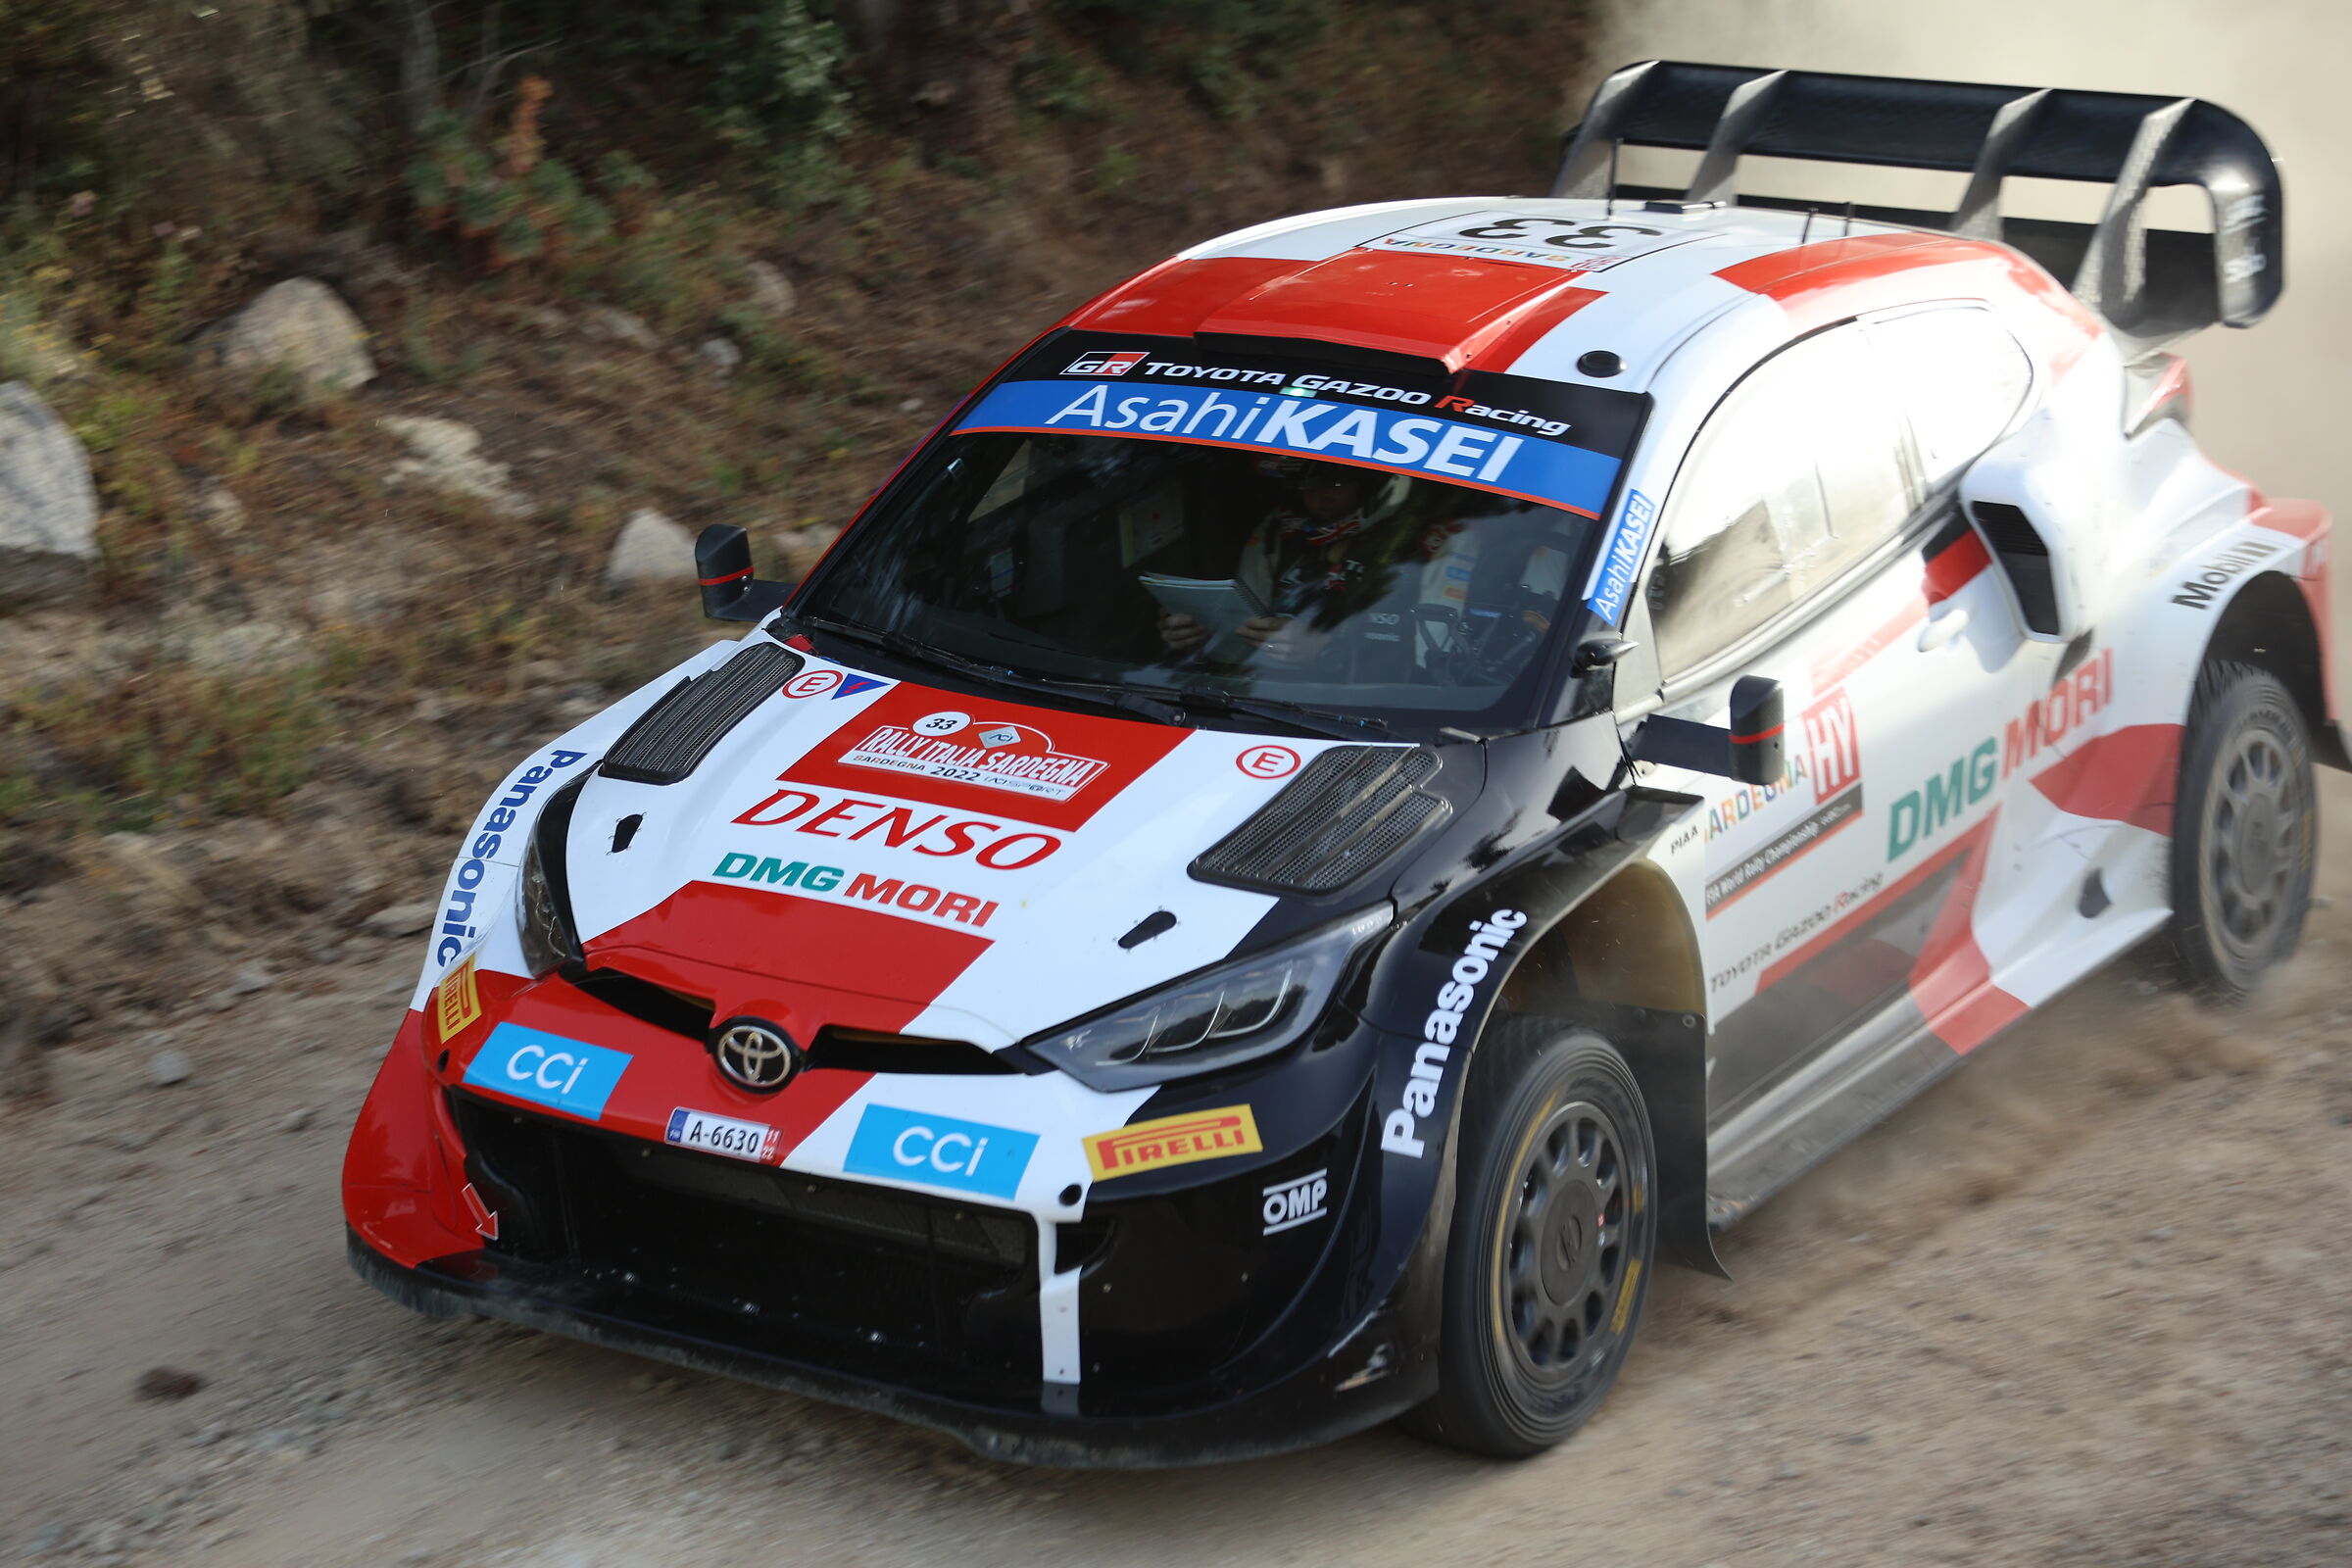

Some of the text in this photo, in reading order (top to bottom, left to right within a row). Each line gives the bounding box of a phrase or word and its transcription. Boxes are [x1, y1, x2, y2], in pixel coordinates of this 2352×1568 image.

[1458, 218, 1662, 249] 33
[1067, 361, 1133, 373] GR
[1145, 362, 1572, 436] TOYOTA GAZOO Racing
[1047, 384, 1524, 482] AsahiKASEI
[1594, 494, 1651, 620] AsahiKASEI
[925, 718, 957, 730] 33
[853, 755, 926, 770] SARDEGNA
[930, 766, 980, 781] 2022
[861, 728, 1097, 786] RALLY ITALIA SARDEGNA
[1251, 752, 1285, 772] E
[1886, 648, 2112, 863] DMG MORI
[731, 789, 1061, 869] DENSO
[437, 750, 588, 968] Panasonic
[712, 852, 1000, 927] DMG MORI
[1381, 909, 1528, 1159] Panasonic
[689, 1120, 760, 1153] A-6630
[1097, 1116, 1247, 1170] PIRELLI
[1263, 1179, 1328, 1226] OMP
